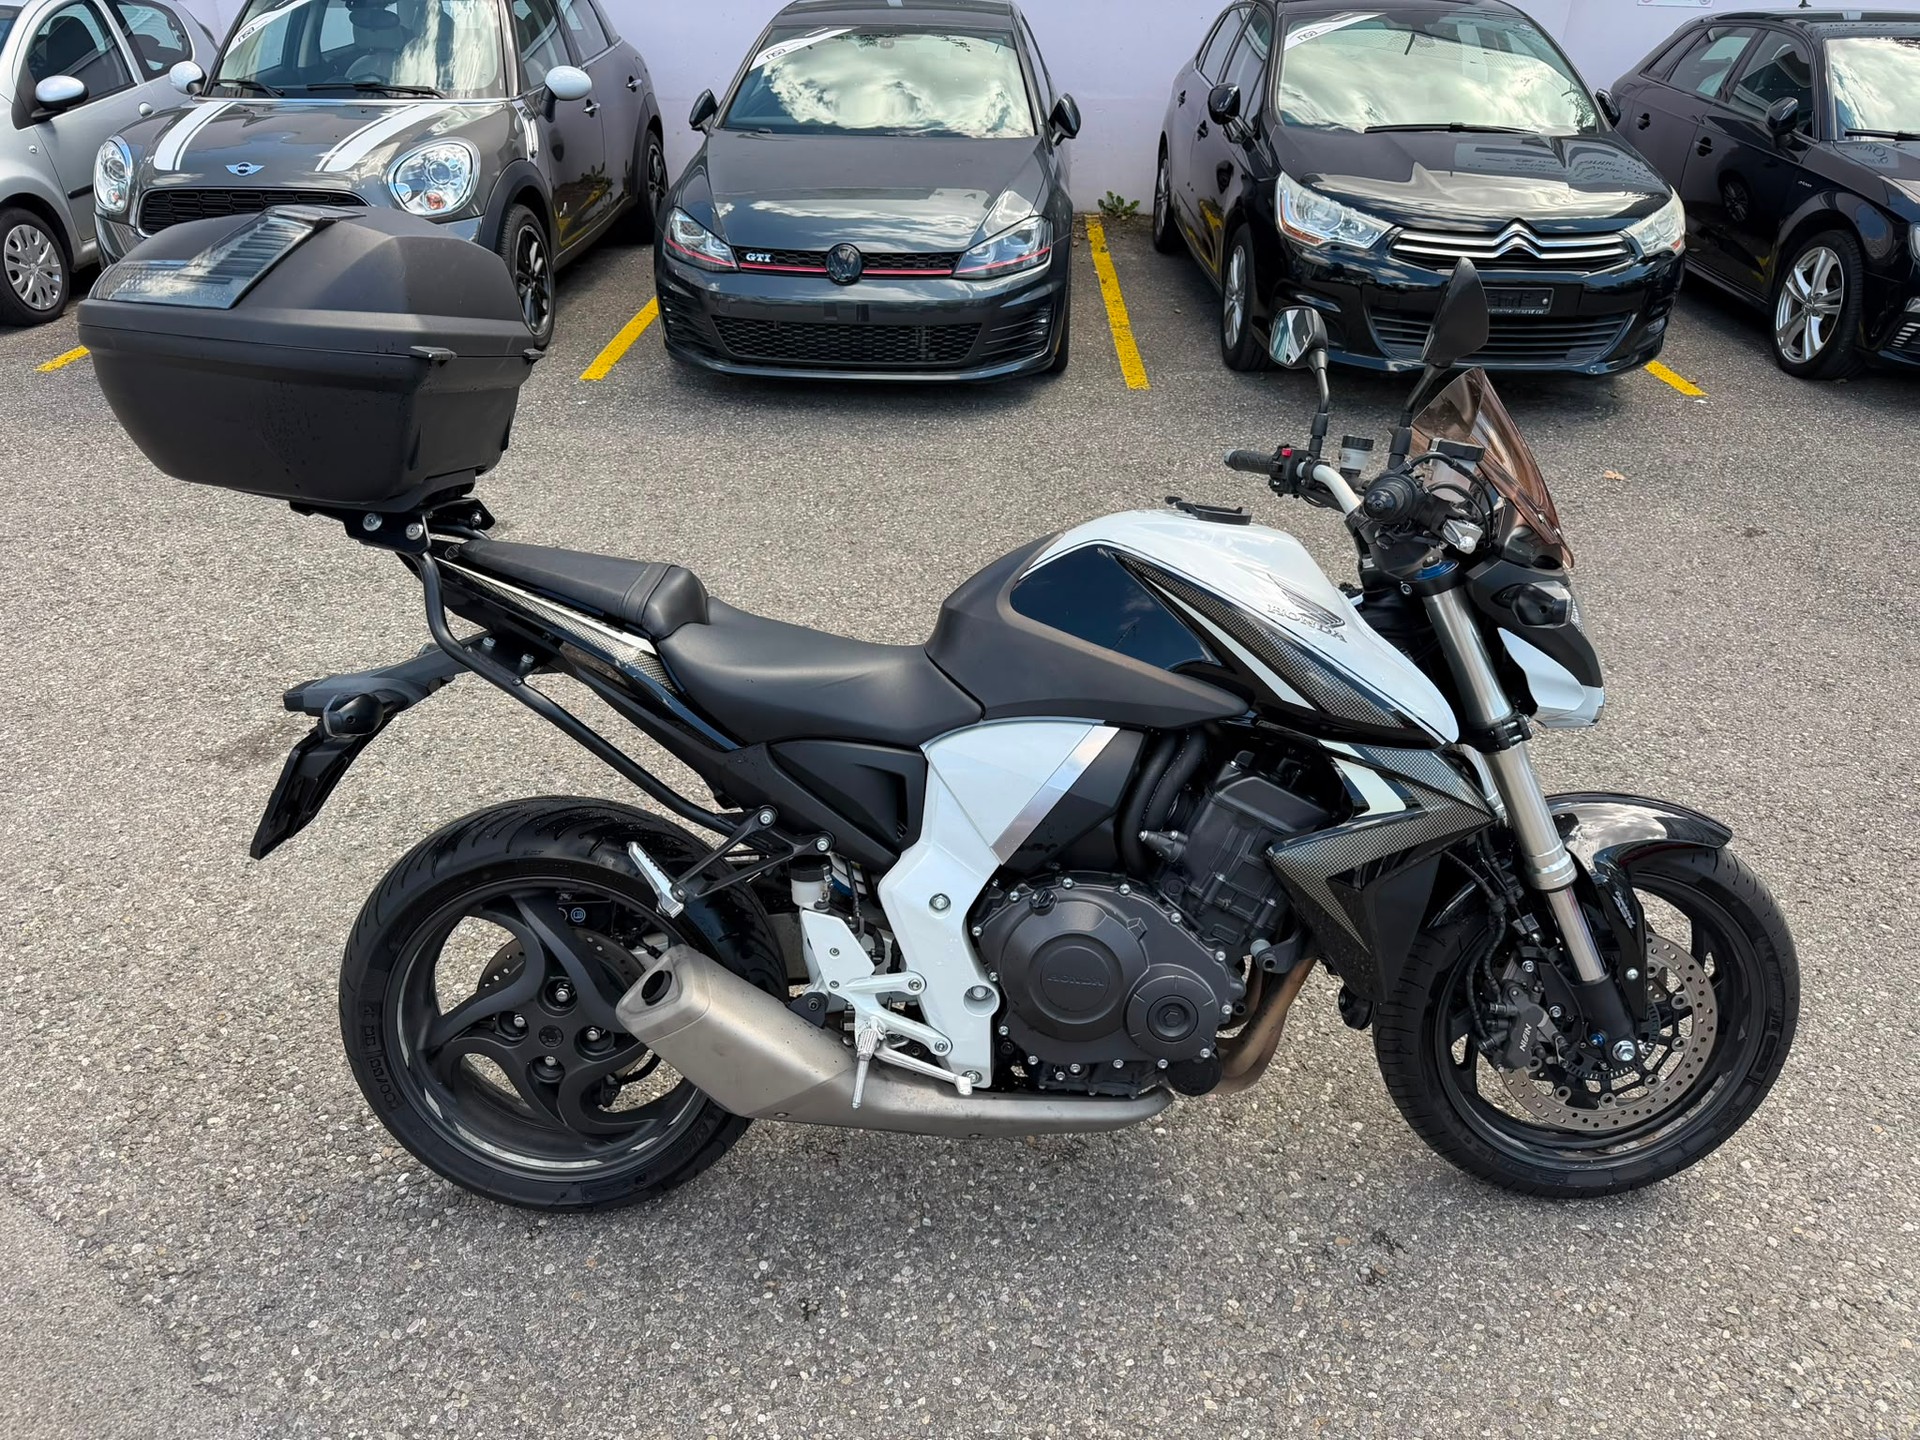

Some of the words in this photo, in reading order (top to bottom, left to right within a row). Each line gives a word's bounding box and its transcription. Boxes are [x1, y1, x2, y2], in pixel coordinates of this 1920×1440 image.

[745, 252, 772, 262] GTI
[1267, 604, 1348, 644] HONDA
[1047, 974, 1105, 987] HONDA
